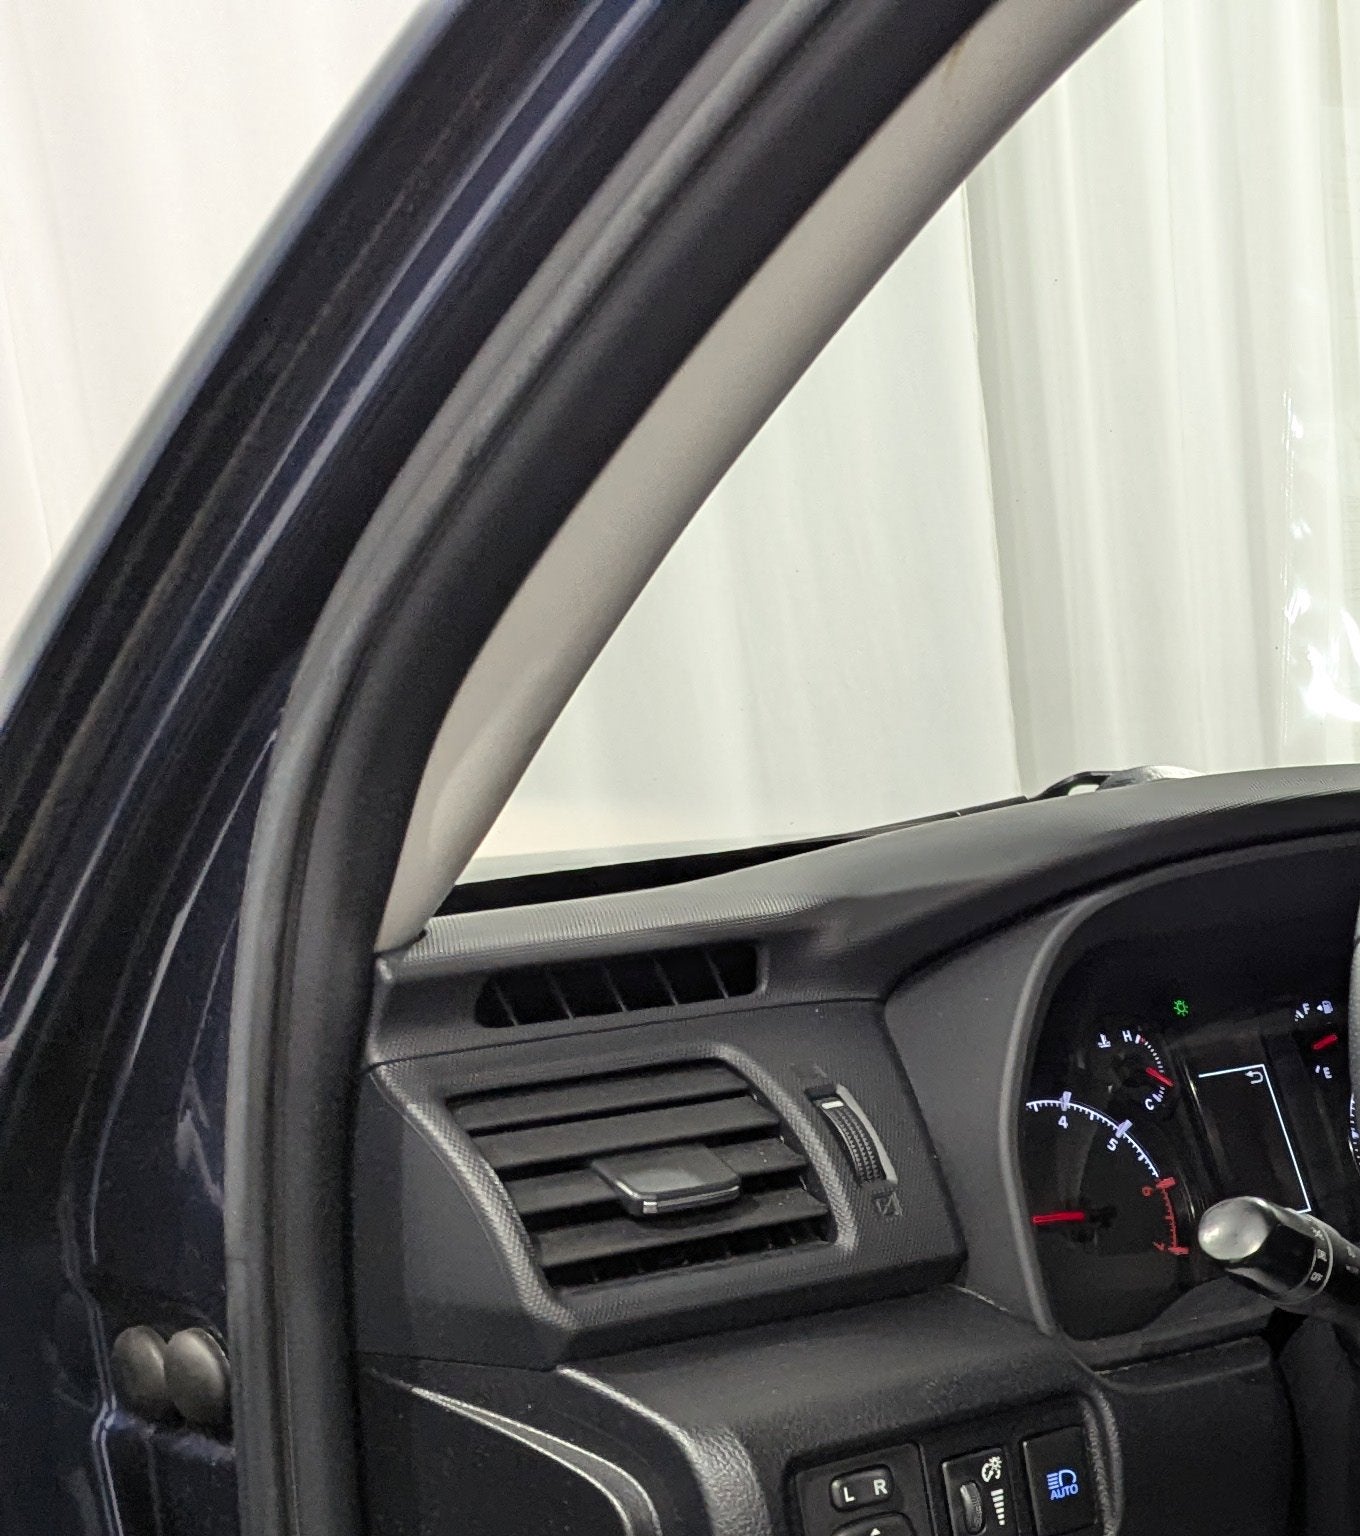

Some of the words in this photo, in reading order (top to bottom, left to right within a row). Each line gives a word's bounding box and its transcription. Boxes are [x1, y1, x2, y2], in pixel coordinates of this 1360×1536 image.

[1302, 1003, 1310, 1015] F
[1122, 1030, 1133, 1043] H
[1323, 1066, 1333, 1079] E
[1145, 1098, 1155, 1111] C
[1058, 1115, 1069, 1129] 4
[1107, 1138, 1118, 1152] 5
[844, 1486, 855, 1502] L
[873, 1479, 888, 1496] R
[1050, 1483, 1079, 1501] AUTO
